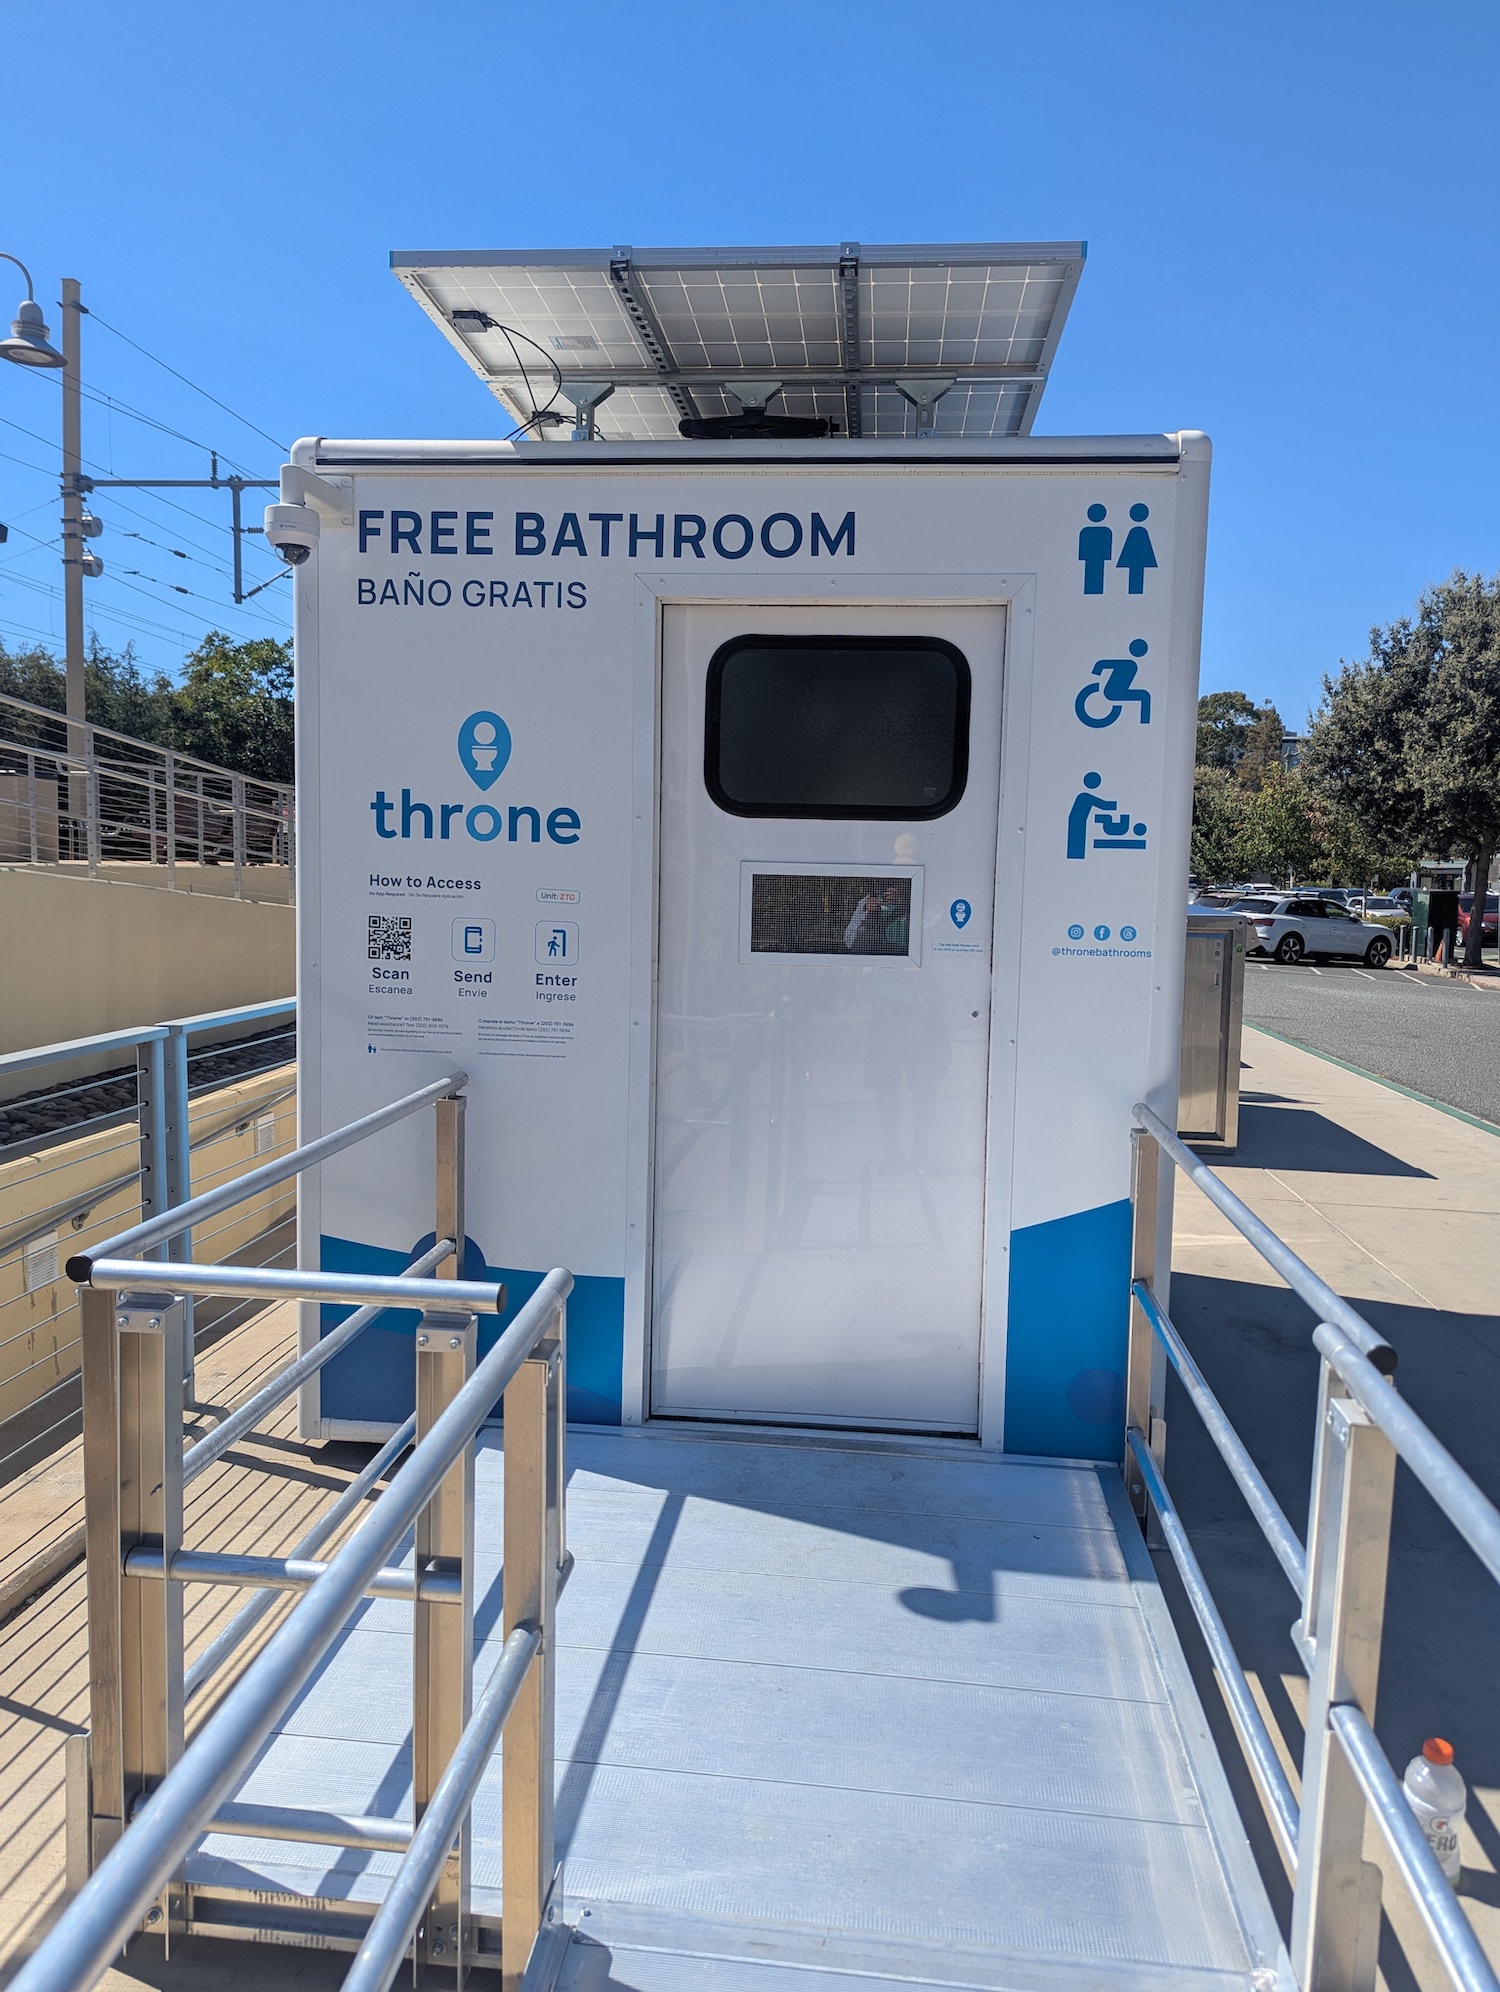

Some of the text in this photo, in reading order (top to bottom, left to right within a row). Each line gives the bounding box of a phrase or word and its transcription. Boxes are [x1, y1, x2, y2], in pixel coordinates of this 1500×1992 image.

[358, 509, 856, 560] FREE BATHROOM
[357, 571, 587, 609] BAÑO GRATIS
[370, 788, 581, 845] throne
[369, 874, 482, 890] How to Access
[541, 892, 576, 901] Unit: ZTG
[1051, 947, 1152, 958] @thronebathrooms
[372, 966, 410, 980] Scan
[453, 970, 492, 984] Send
[535, 973, 578, 987] Enter
[368, 984, 413, 995] Escanea
[458, 987, 488, 998] Envie
[536, 991, 576, 1003] Ingrese
[1426, 1834, 1457, 1851] ERO
